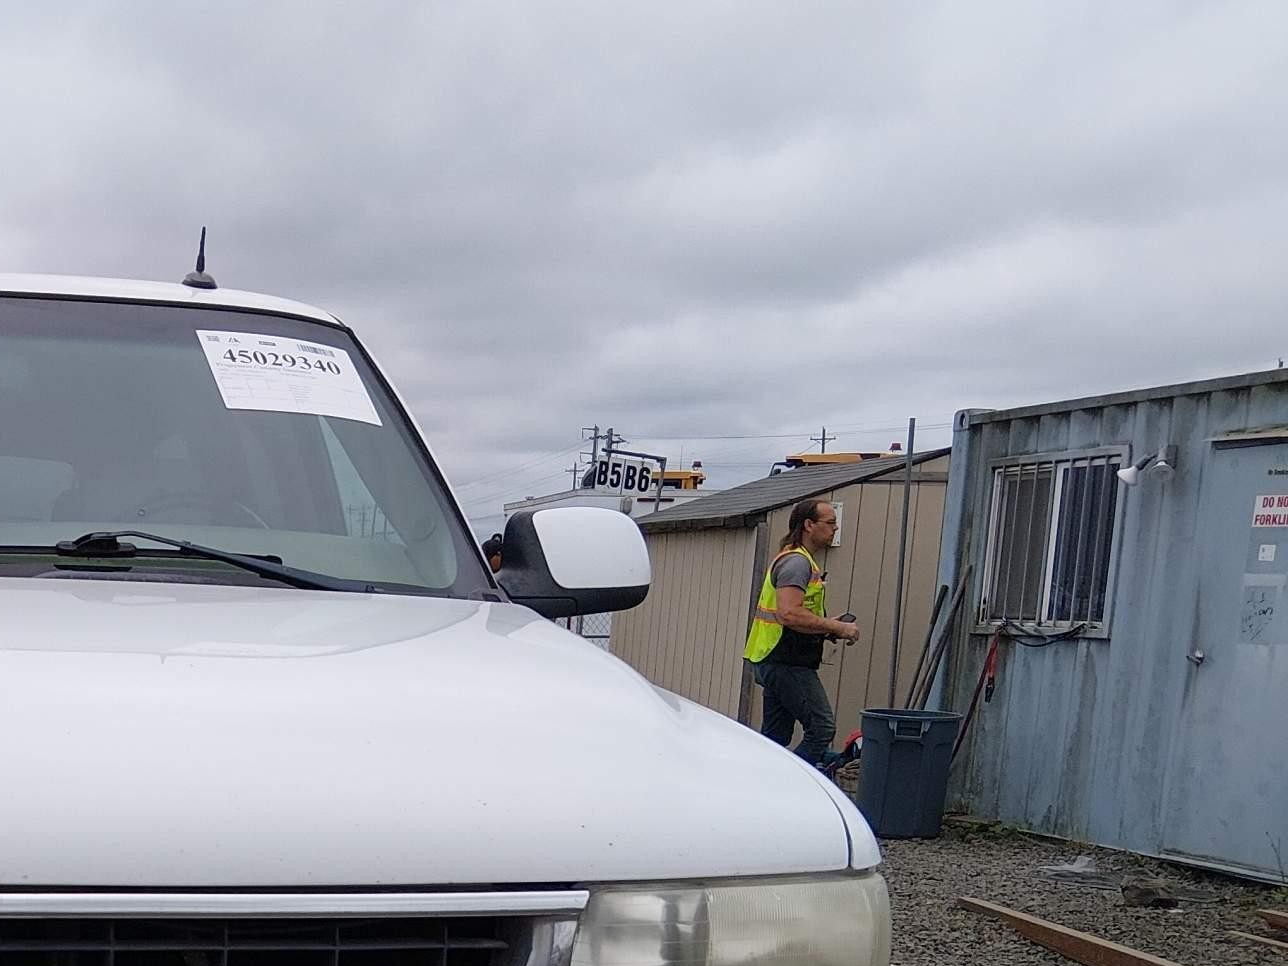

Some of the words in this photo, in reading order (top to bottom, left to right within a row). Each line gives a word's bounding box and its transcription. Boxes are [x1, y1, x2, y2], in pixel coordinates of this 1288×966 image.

[223, 346, 341, 375] 45029340
[597, 460, 622, 488] B5
[624, 464, 651, 492] B6
[1262, 496, 1275, 508] DO
